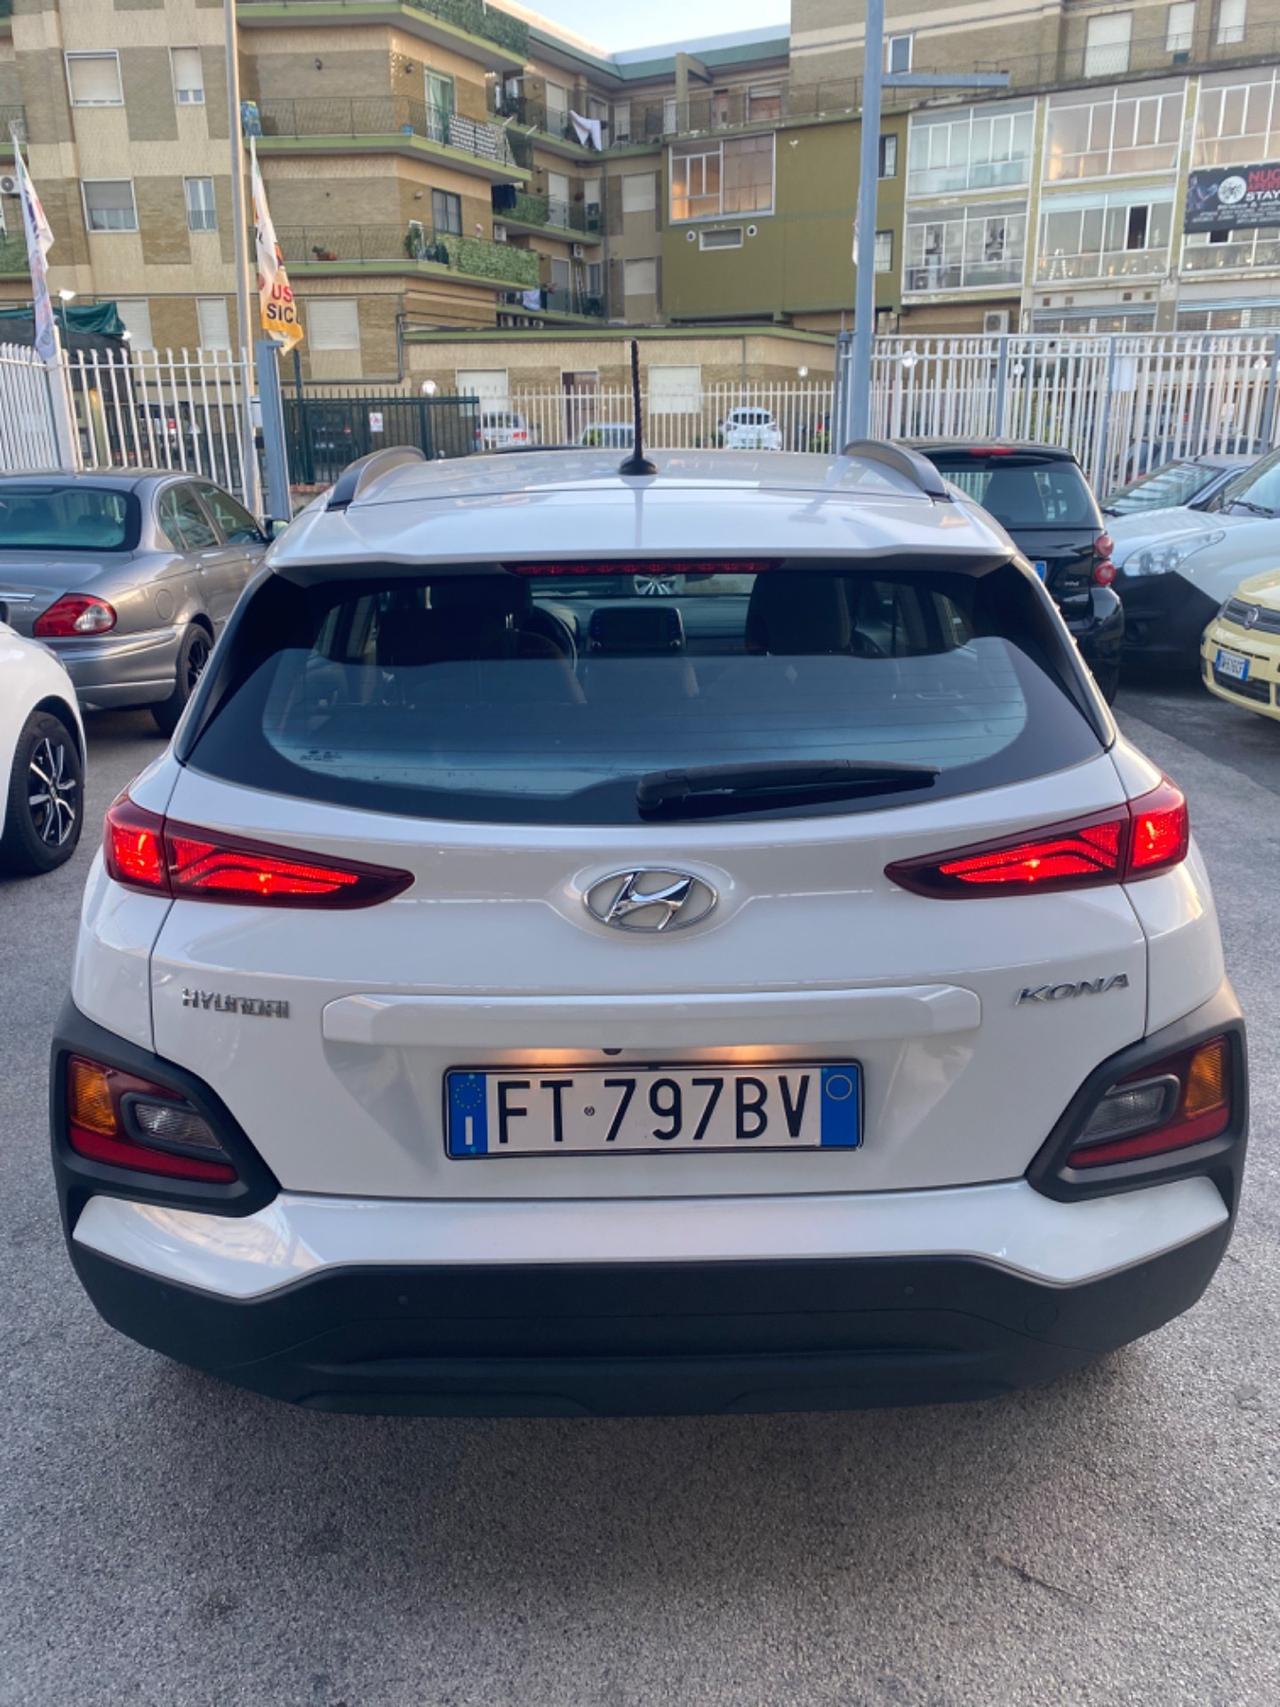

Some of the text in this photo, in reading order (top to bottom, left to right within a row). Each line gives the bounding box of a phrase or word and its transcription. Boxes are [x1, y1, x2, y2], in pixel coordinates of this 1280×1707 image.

[266, 303, 299, 324] SIC
[182, 987, 290, 1020] HYUNDAI
[1015, 971, 1130, 1006] KONA
